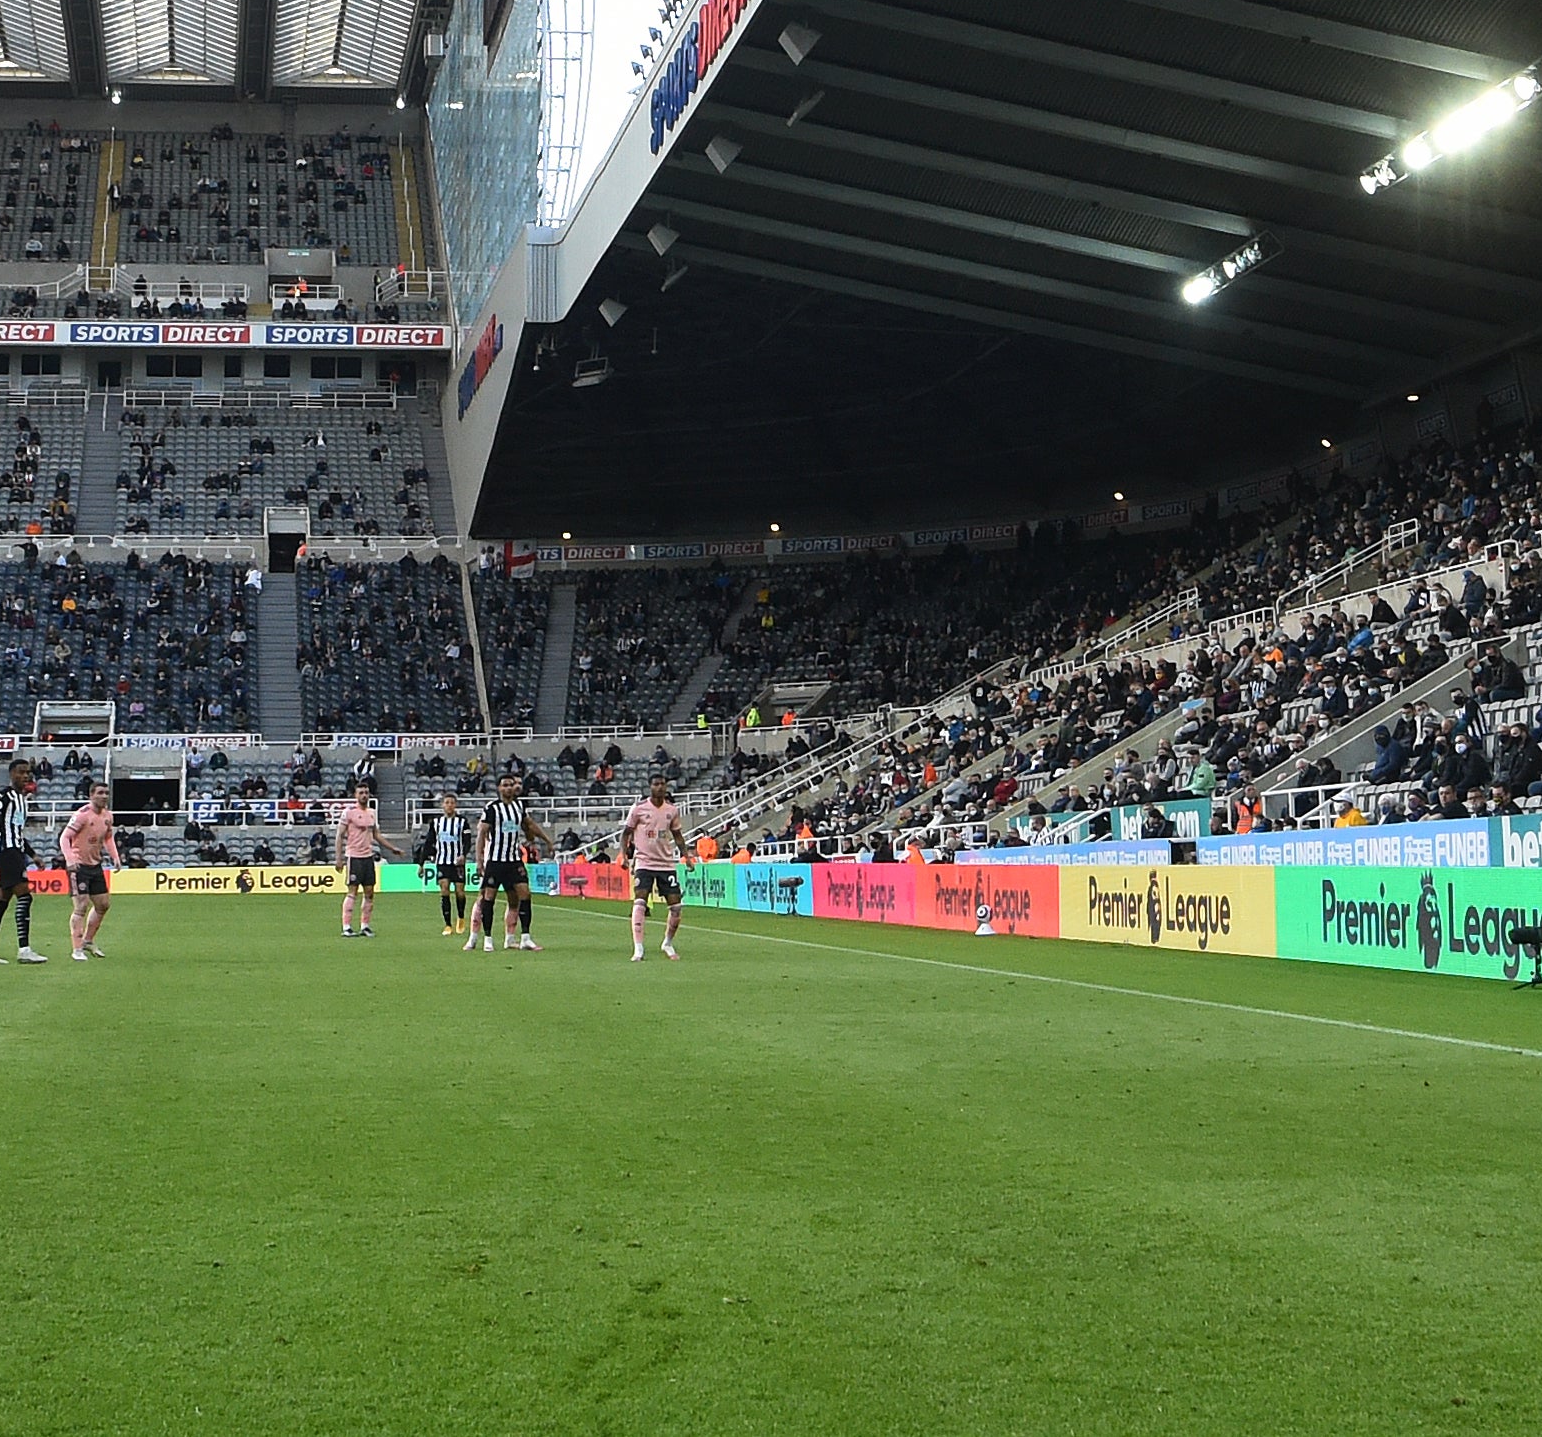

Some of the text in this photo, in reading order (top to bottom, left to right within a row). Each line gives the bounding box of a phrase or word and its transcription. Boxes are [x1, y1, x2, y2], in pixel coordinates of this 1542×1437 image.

[76, 325, 245, 343] SPORTS DIRECT
[271, 326, 437, 345] SPORTS DIRECT
[1143, 500, 1187, 520] SPORTS
[784, 535, 896, 553] SPORTS DIRECT
[916, 524, 1018, 544] SPORTS DIRECT
[568, 546, 622, 560] DIRECT
[647, 542, 761, 560] SPORTS DIRECT
[126, 736, 185, 749] SPORTS
[338, 735, 394, 749] SPORTS
[1283, 841, 1324, 866] FUN88
[1354, 837, 1401, 866] FUN88
[1435, 831, 1488, 867] FUN88
[155, 870, 334, 894] Premier League
[935, 872, 1031, 934] Premier League
[1088, 875, 1231, 950] Premier League
[1321, 879, 1411, 949] Premier
